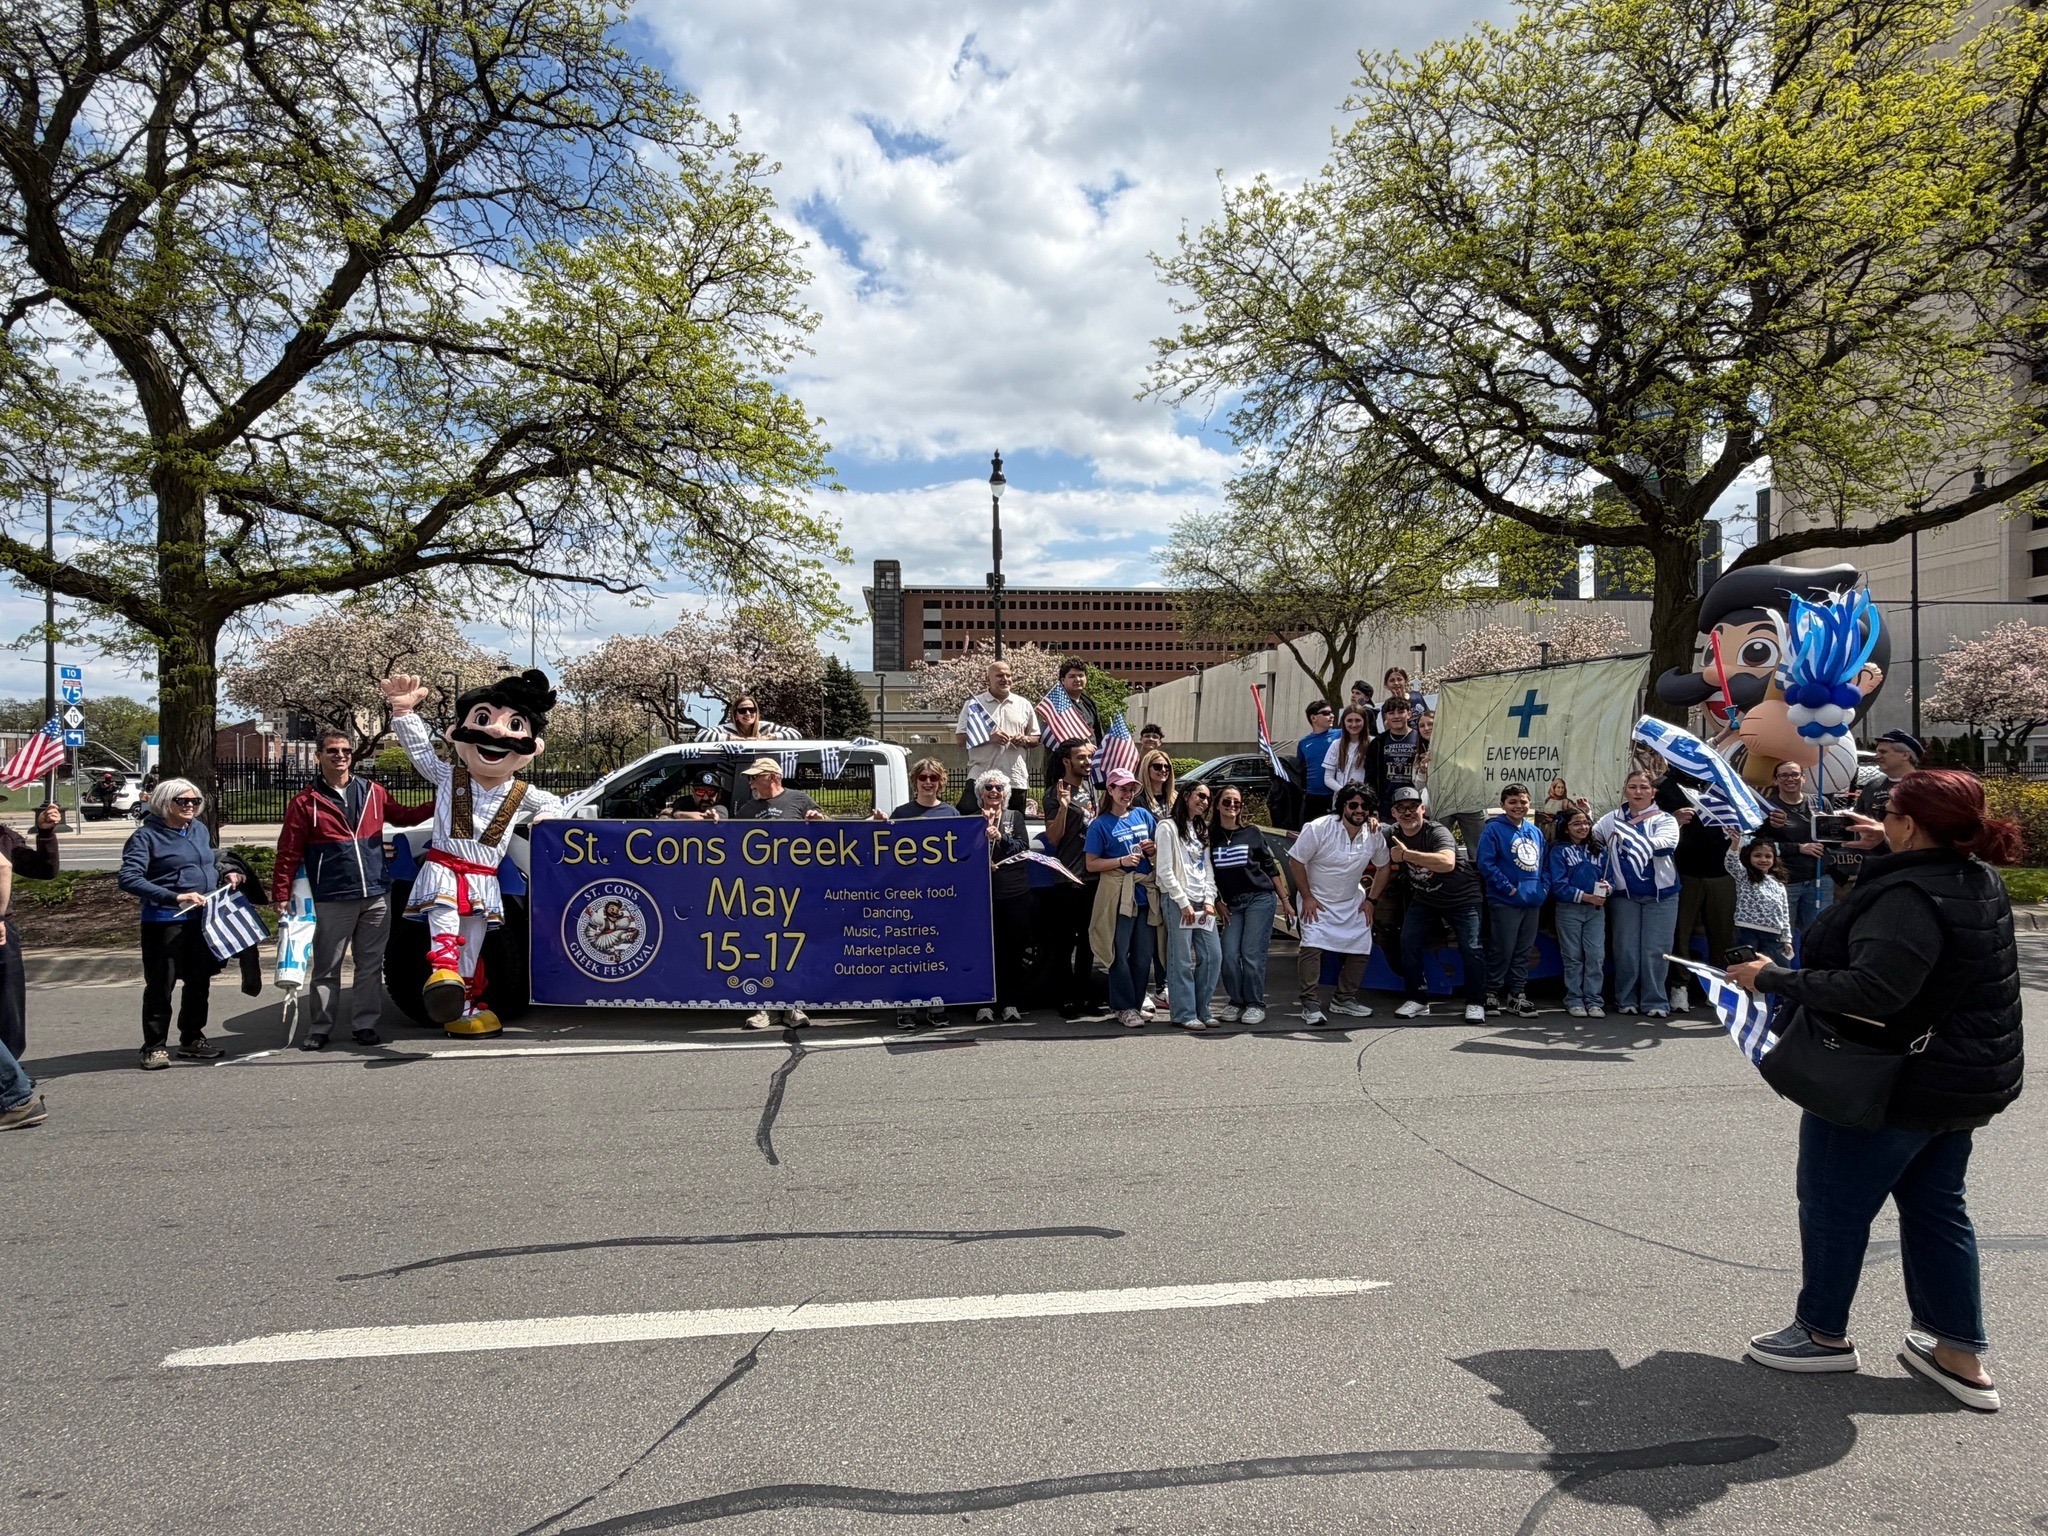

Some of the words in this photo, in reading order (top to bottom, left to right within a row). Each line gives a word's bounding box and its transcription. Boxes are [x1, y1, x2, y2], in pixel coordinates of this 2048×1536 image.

[66, 669, 77, 678] TO
[63, 685, 81, 700] 75
[69, 714, 79, 724] 10
[1486, 745, 1560, 762] ΕΛΕΥΘΕΡΙΑ
[1500, 767, 1561, 783] ΘΑΝΑΤΟΣ
[563, 828, 609, 864] St.
[625, 828, 726, 865] Cons
[742, 828, 861, 866] Greek
[872, 830, 958, 866] Fest
[584, 887, 601, 901] ST.
[604, 884, 640, 901] CONS
[823, 888, 880, 901] Authentic
[884, 887, 923, 900] Greek
[927, 885, 958, 898] food,
[706, 876, 801, 928] May
[862, 906, 914, 921] Dancing,
[843, 925, 881, 939] Music,
[884, 924, 939, 937] Pastries,
[700, 931, 807, 972] 15-17
[843, 944, 921, 958] Marketplace
[925, 942, 935, 954] &
[569, 942, 600, 974] GREEK
[603, 943, 655, 976] FESTIVAL
[834, 962, 885, 975] Outdoor
[889, 960, 949, 974] activities,
